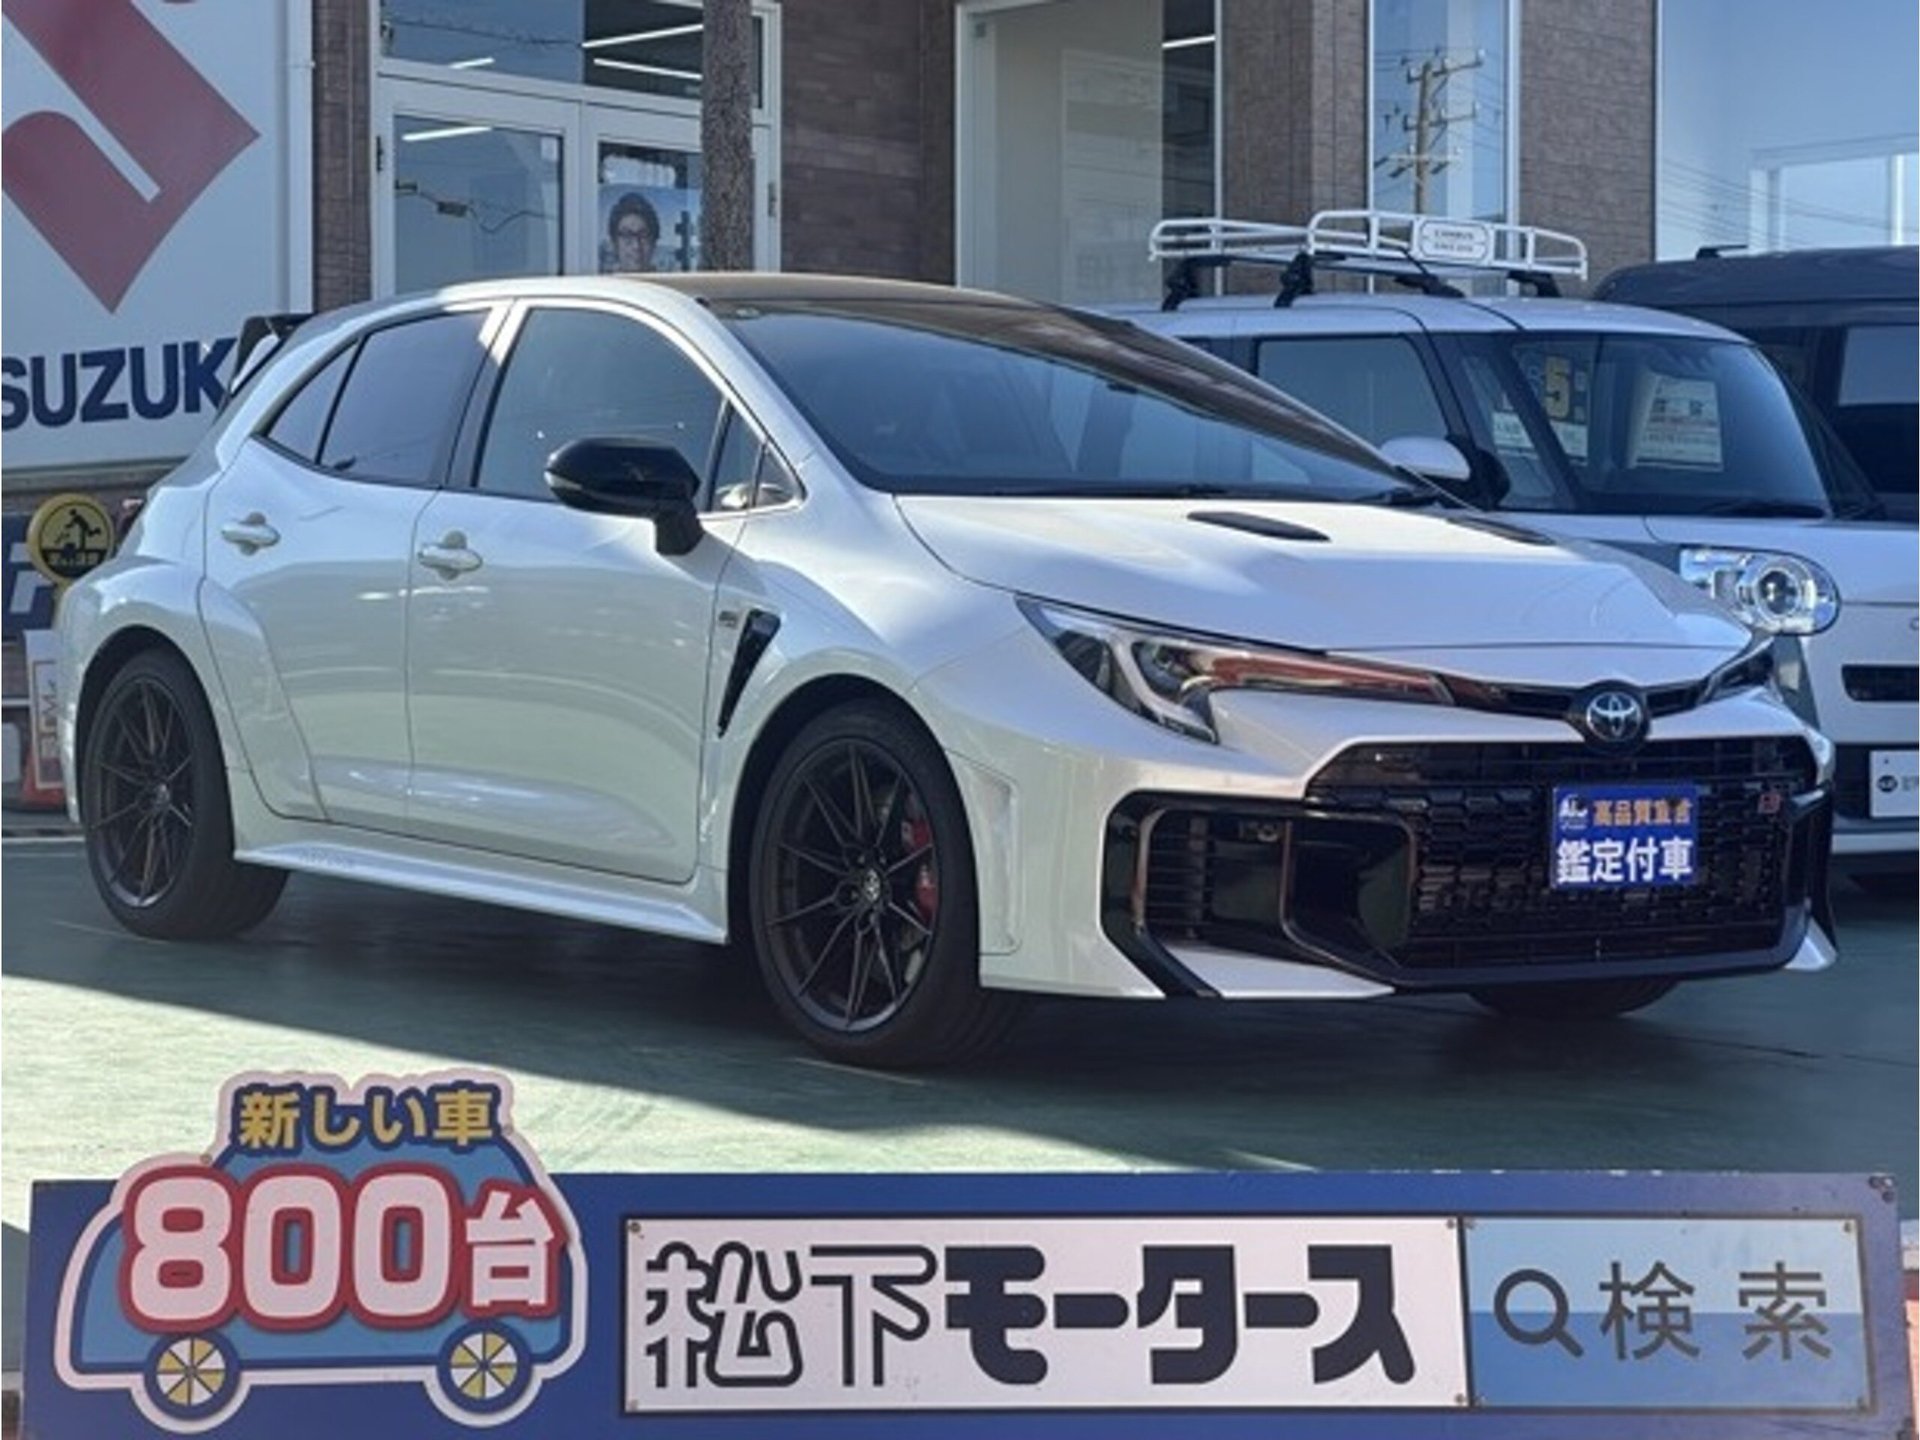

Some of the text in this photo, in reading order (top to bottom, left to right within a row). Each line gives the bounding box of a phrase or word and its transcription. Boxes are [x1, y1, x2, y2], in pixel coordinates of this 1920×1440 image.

[1557, 836, 1693, 883] 鑑定付車
[238, 1090, 495, 1148] 新しい車
[130, 1173, 554, 1322] 800台
[645, 1241, 1415, 1386] 松下モータース
[1598, 1261, 1833, 1361] 検索
